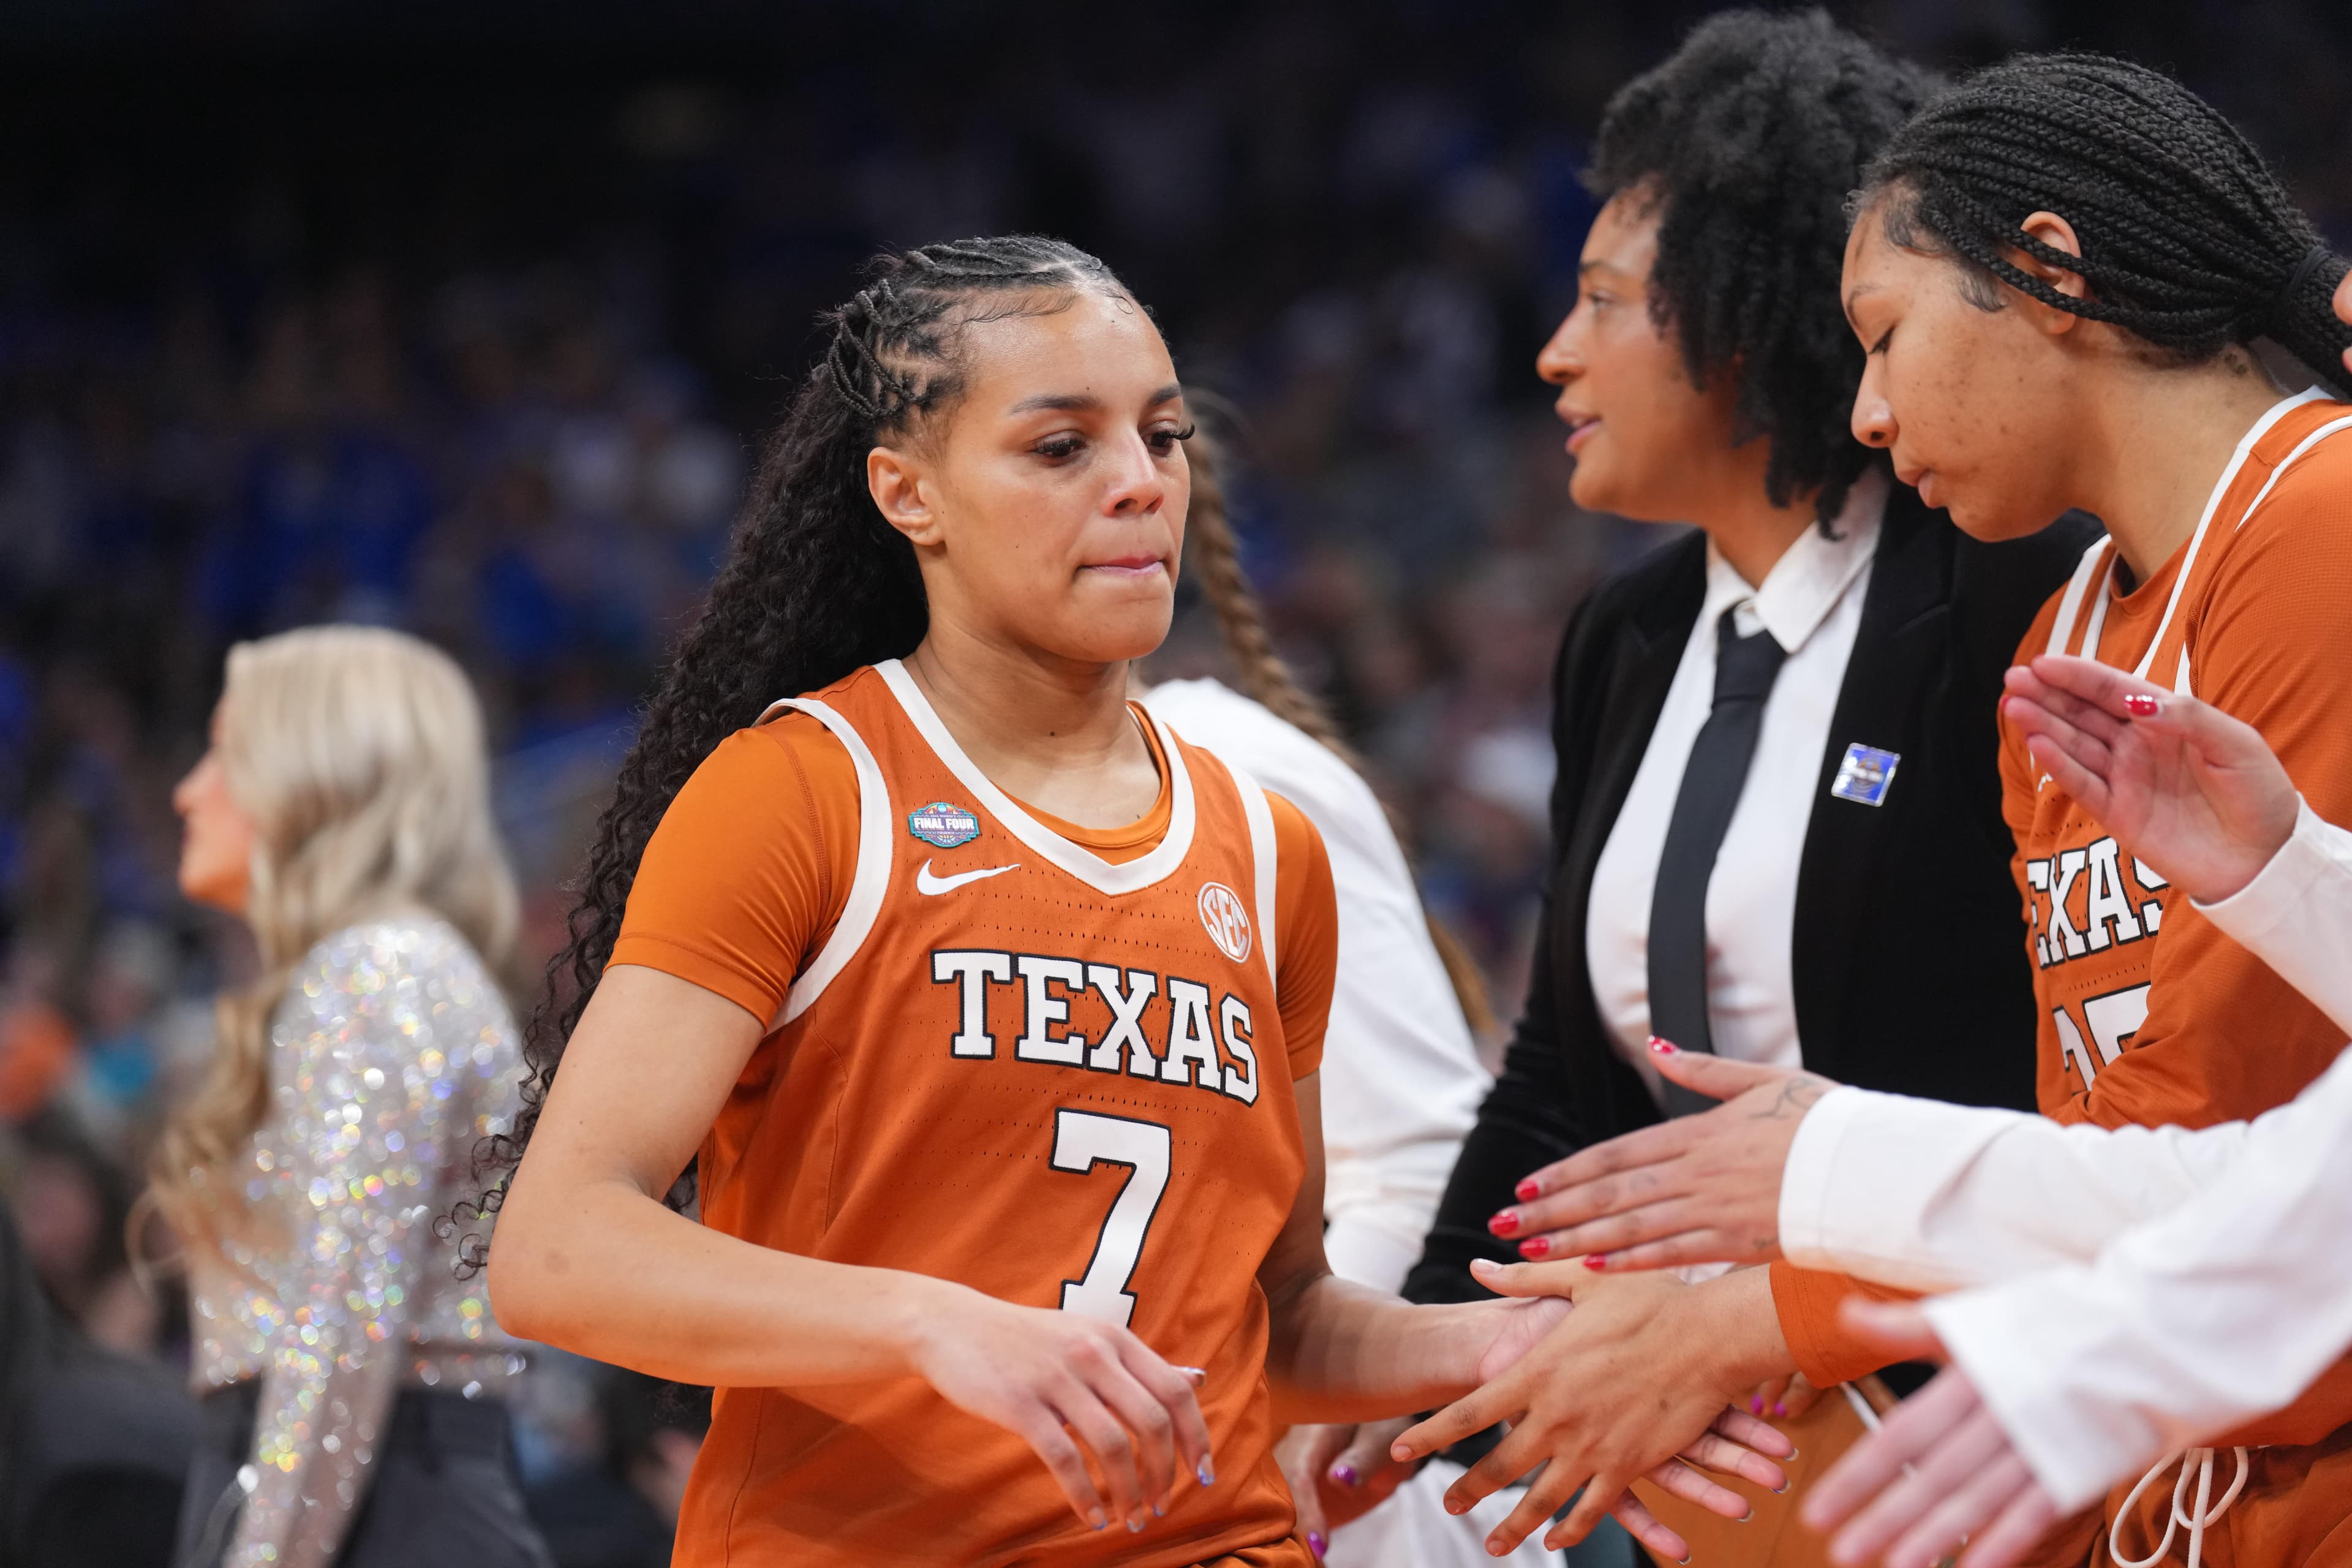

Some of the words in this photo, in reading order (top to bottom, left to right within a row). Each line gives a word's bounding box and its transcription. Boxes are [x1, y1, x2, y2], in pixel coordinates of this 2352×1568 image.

[913, 817, 944, 829] FINAL
[945, 818, 974, 829] FOUR
[1203, 888, 1248, 957] SEC
[931, 948, 1259, 1107] TEXAS
[1049, 1107, 1172, 1329] 7
